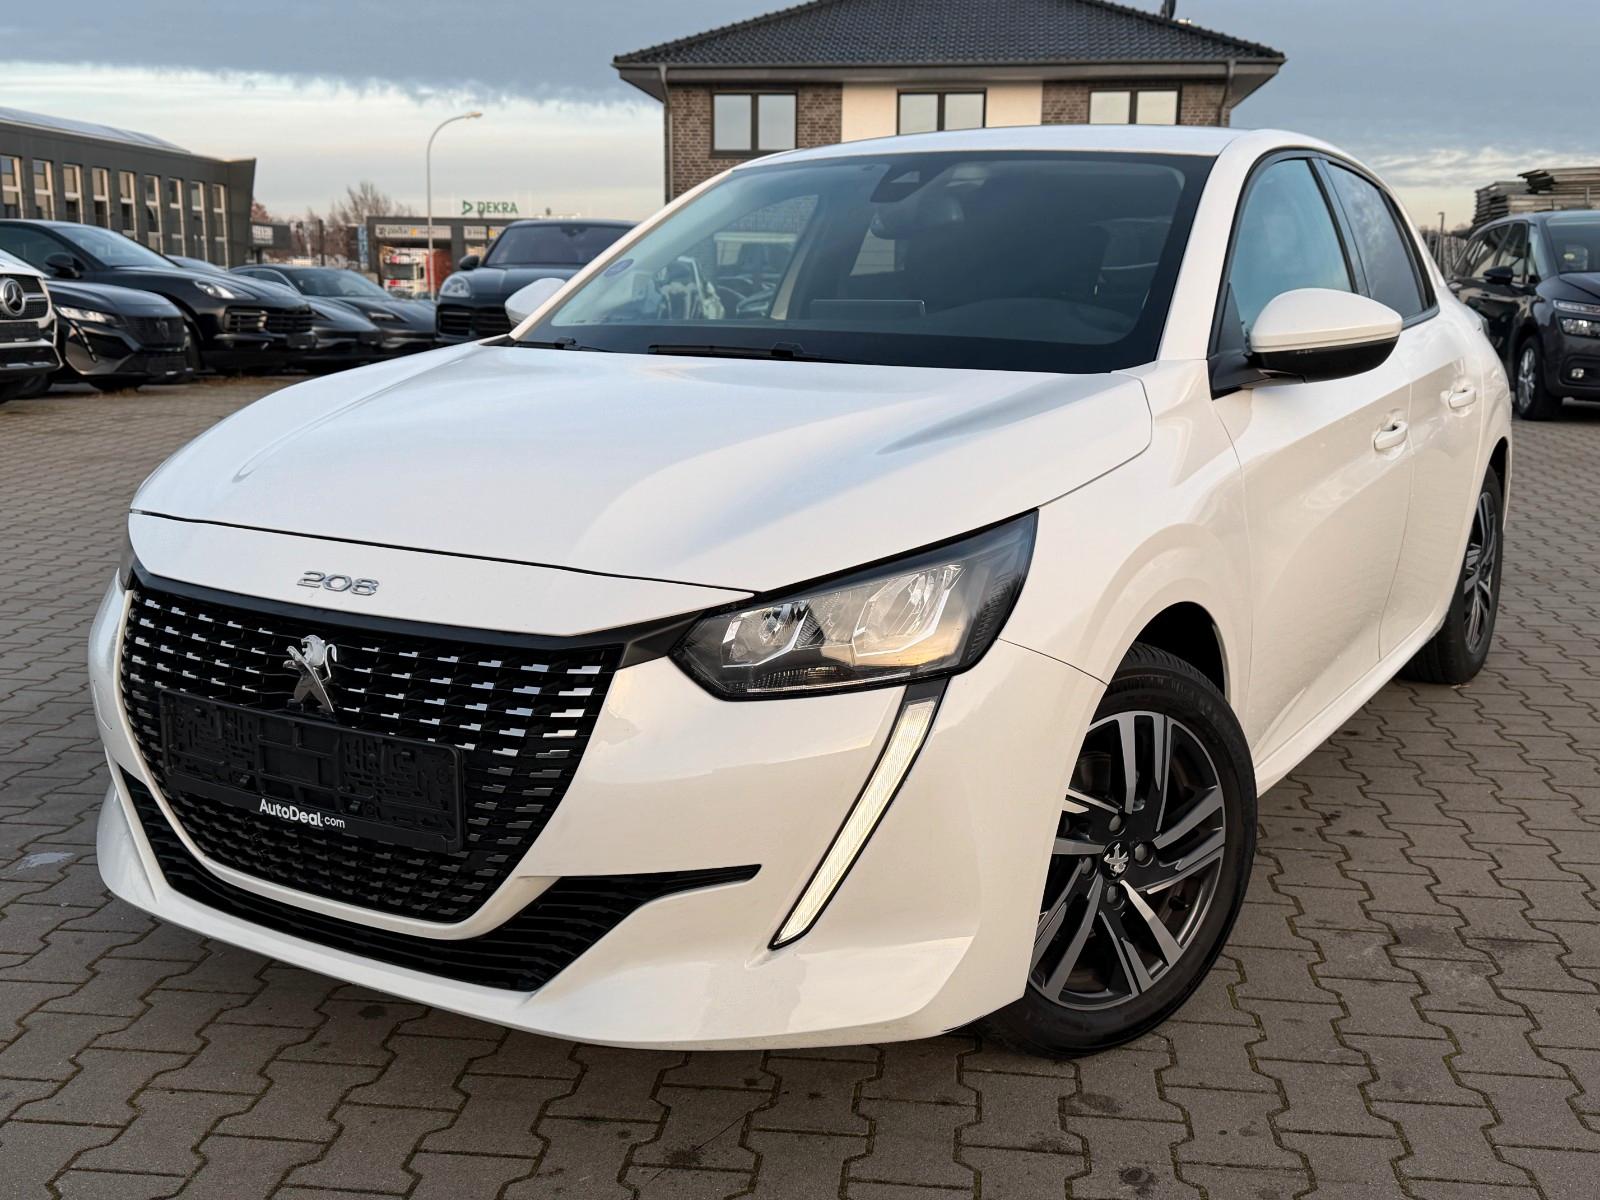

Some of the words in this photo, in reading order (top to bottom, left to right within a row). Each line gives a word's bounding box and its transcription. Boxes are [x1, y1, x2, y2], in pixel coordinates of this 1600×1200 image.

[477, 201, 518, 214] DEKRA
[297, 570, 380, 596] 208
[259, 798, 345, 829] AutoDeal.com
